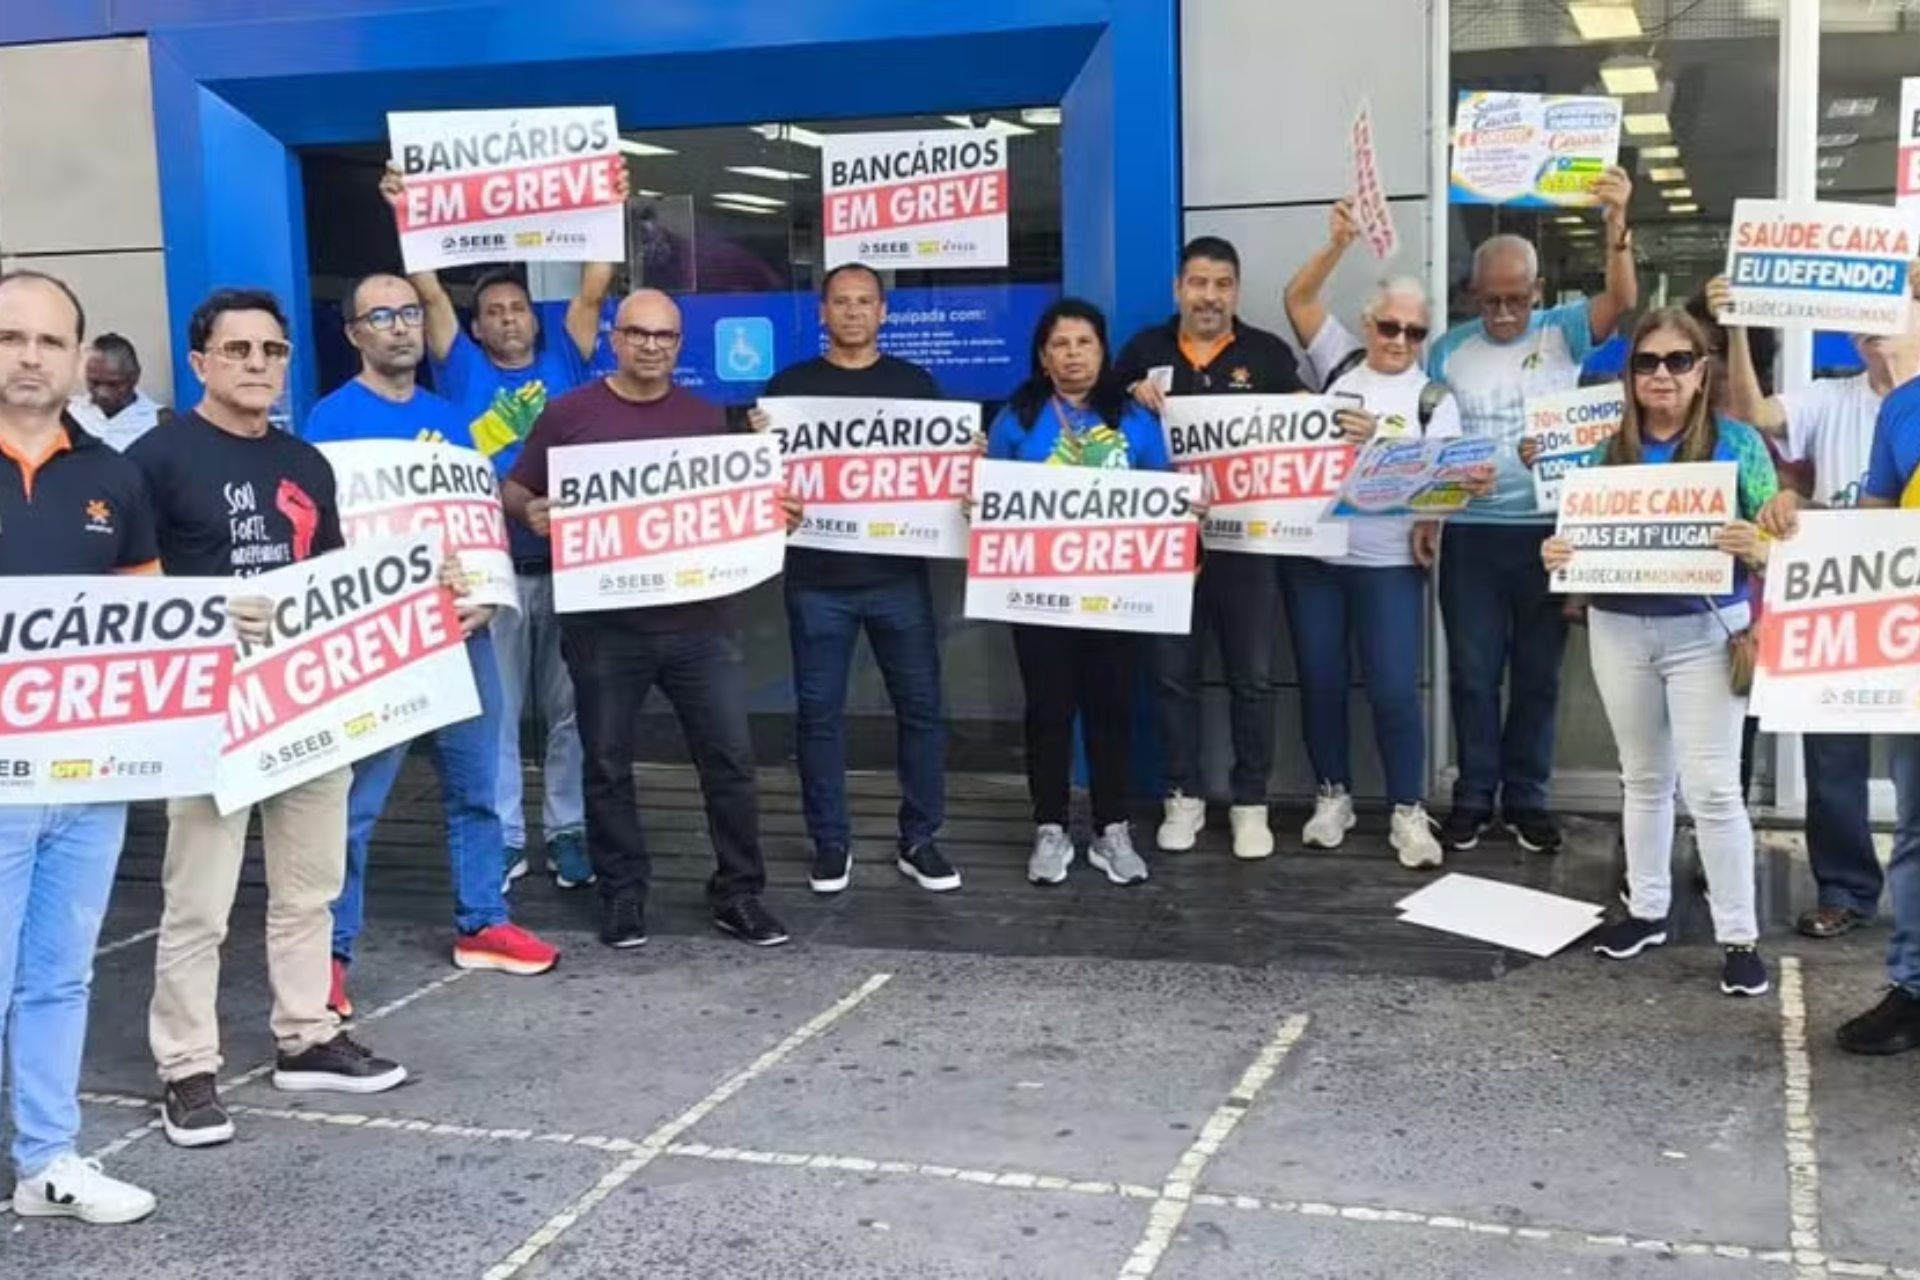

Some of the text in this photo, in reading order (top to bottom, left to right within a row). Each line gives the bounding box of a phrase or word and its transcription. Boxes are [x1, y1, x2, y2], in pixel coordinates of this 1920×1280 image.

[403, 119, 609, 174] BANCÁRIOS
[831, 139, 999, 187] BANCÁRIOS
[407, 160, 610, 227] EM GREVE
[831, 175, 998, 233] EM GREVE
[1737, 214, 1909, 254] SAÚDE CAIXA
[1737, 259, 1896, 290] EU DEFENDO!
[886, 309, 946, 325] quipada
[770, 409, 973, 454] BANCÁRIOS
[1170, 405, 1347, 455] BANCÁRIOS
[1566, 401, 1624, 424] COMPR
[345, 453, 498, 508] ANCÁRIO
[560, 447, 772, 508] BANCÁRIOS
[785, 456, 969, 501] M GREVE
[1226, 451, 1347, 499] GREVE
[981, 478, 1191, 522] BANCÁRIOS
[1564, 485, 1640, 516] SAÚDE
[1650, 488, 1726, 515] CAIXA
[411, 504, 505, 545] GREV
[561, 489, 774, 566] EM GREVE
[1613, 527, 1641, 546] EM
[977, 527, 1186, 574] EM GREVE
[1784, 546, 1920, 601] BANC
[234, 545, 432, 662] CÁRIOS
[1780, 604, 1920, 670] EM G
[1, 652, 220, 728] GREVE
[226, 594, 446, 742] M GREVE
[1842, 690, 1904, 704] SEEB
[0, 760, 31, 777] EB
[118, 761, 162, 775] FEEB
[278, 729, 334, 763] SEEB
